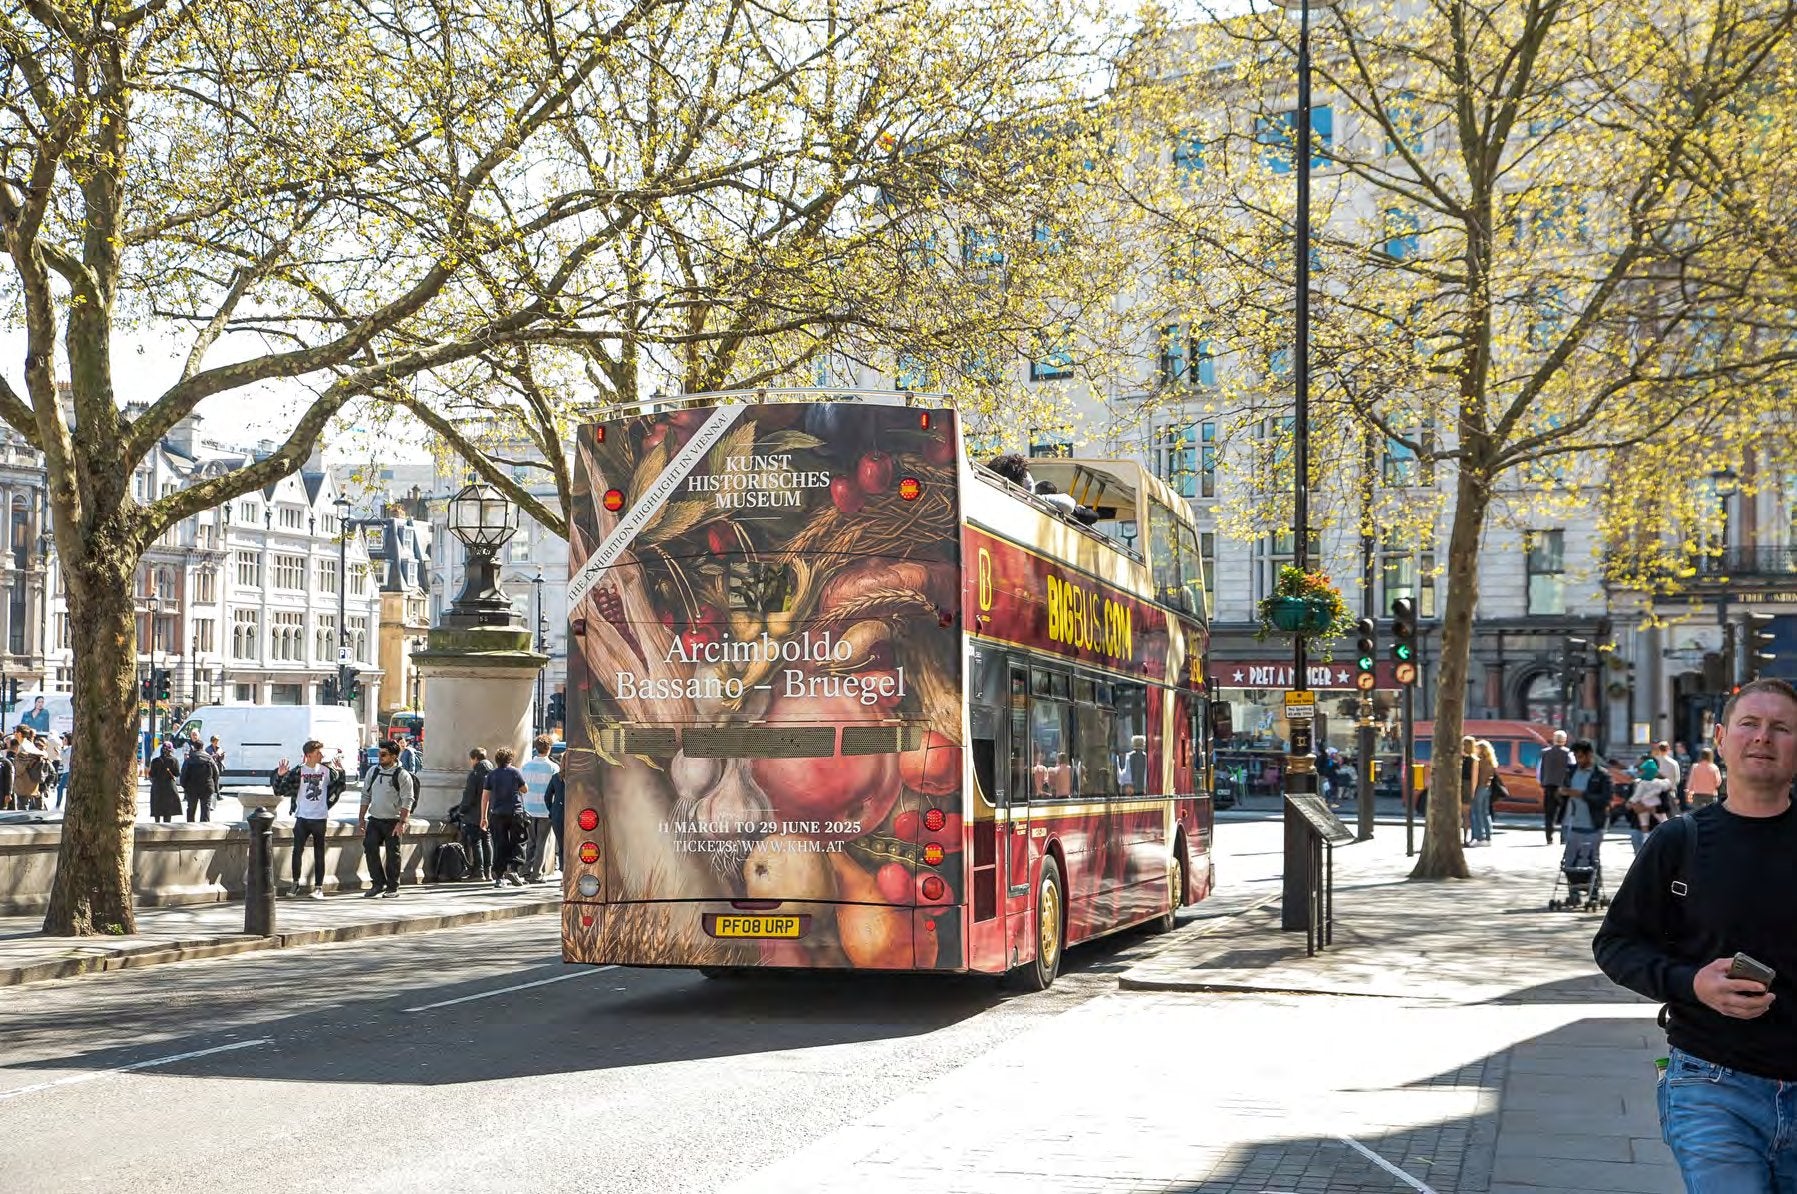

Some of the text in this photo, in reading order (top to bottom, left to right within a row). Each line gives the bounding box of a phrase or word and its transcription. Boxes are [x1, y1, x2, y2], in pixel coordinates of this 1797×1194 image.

[725, 454, 792, 472] KUNST
[687, 471, 830, 492] HISTORISCHES
[568, 413, 728, 601] THE EXHIBITION HIGHLIGHT IN VIENNA!
[714, 491, 802, 509] MUSEUM
[663, 631, 853, 663] Arcimboldo
[1249, 666, 1332, 685] PRET A MNGER
[614, 671, 744, 700] Bassano
[783, 667, 906, 706] Bruegel
[674, 821, 730, 834] MARCH
[735, 821, 756, 833] TO
[759, 821, 778, 833] 29
[780, 821, 821, 836] JUNE
[824, 821, 861, 833] 2025
[673, 840, 845, 853] TICKETS: WWW.KHM.AT
[722, 919, 794, 933] PF08 URP
